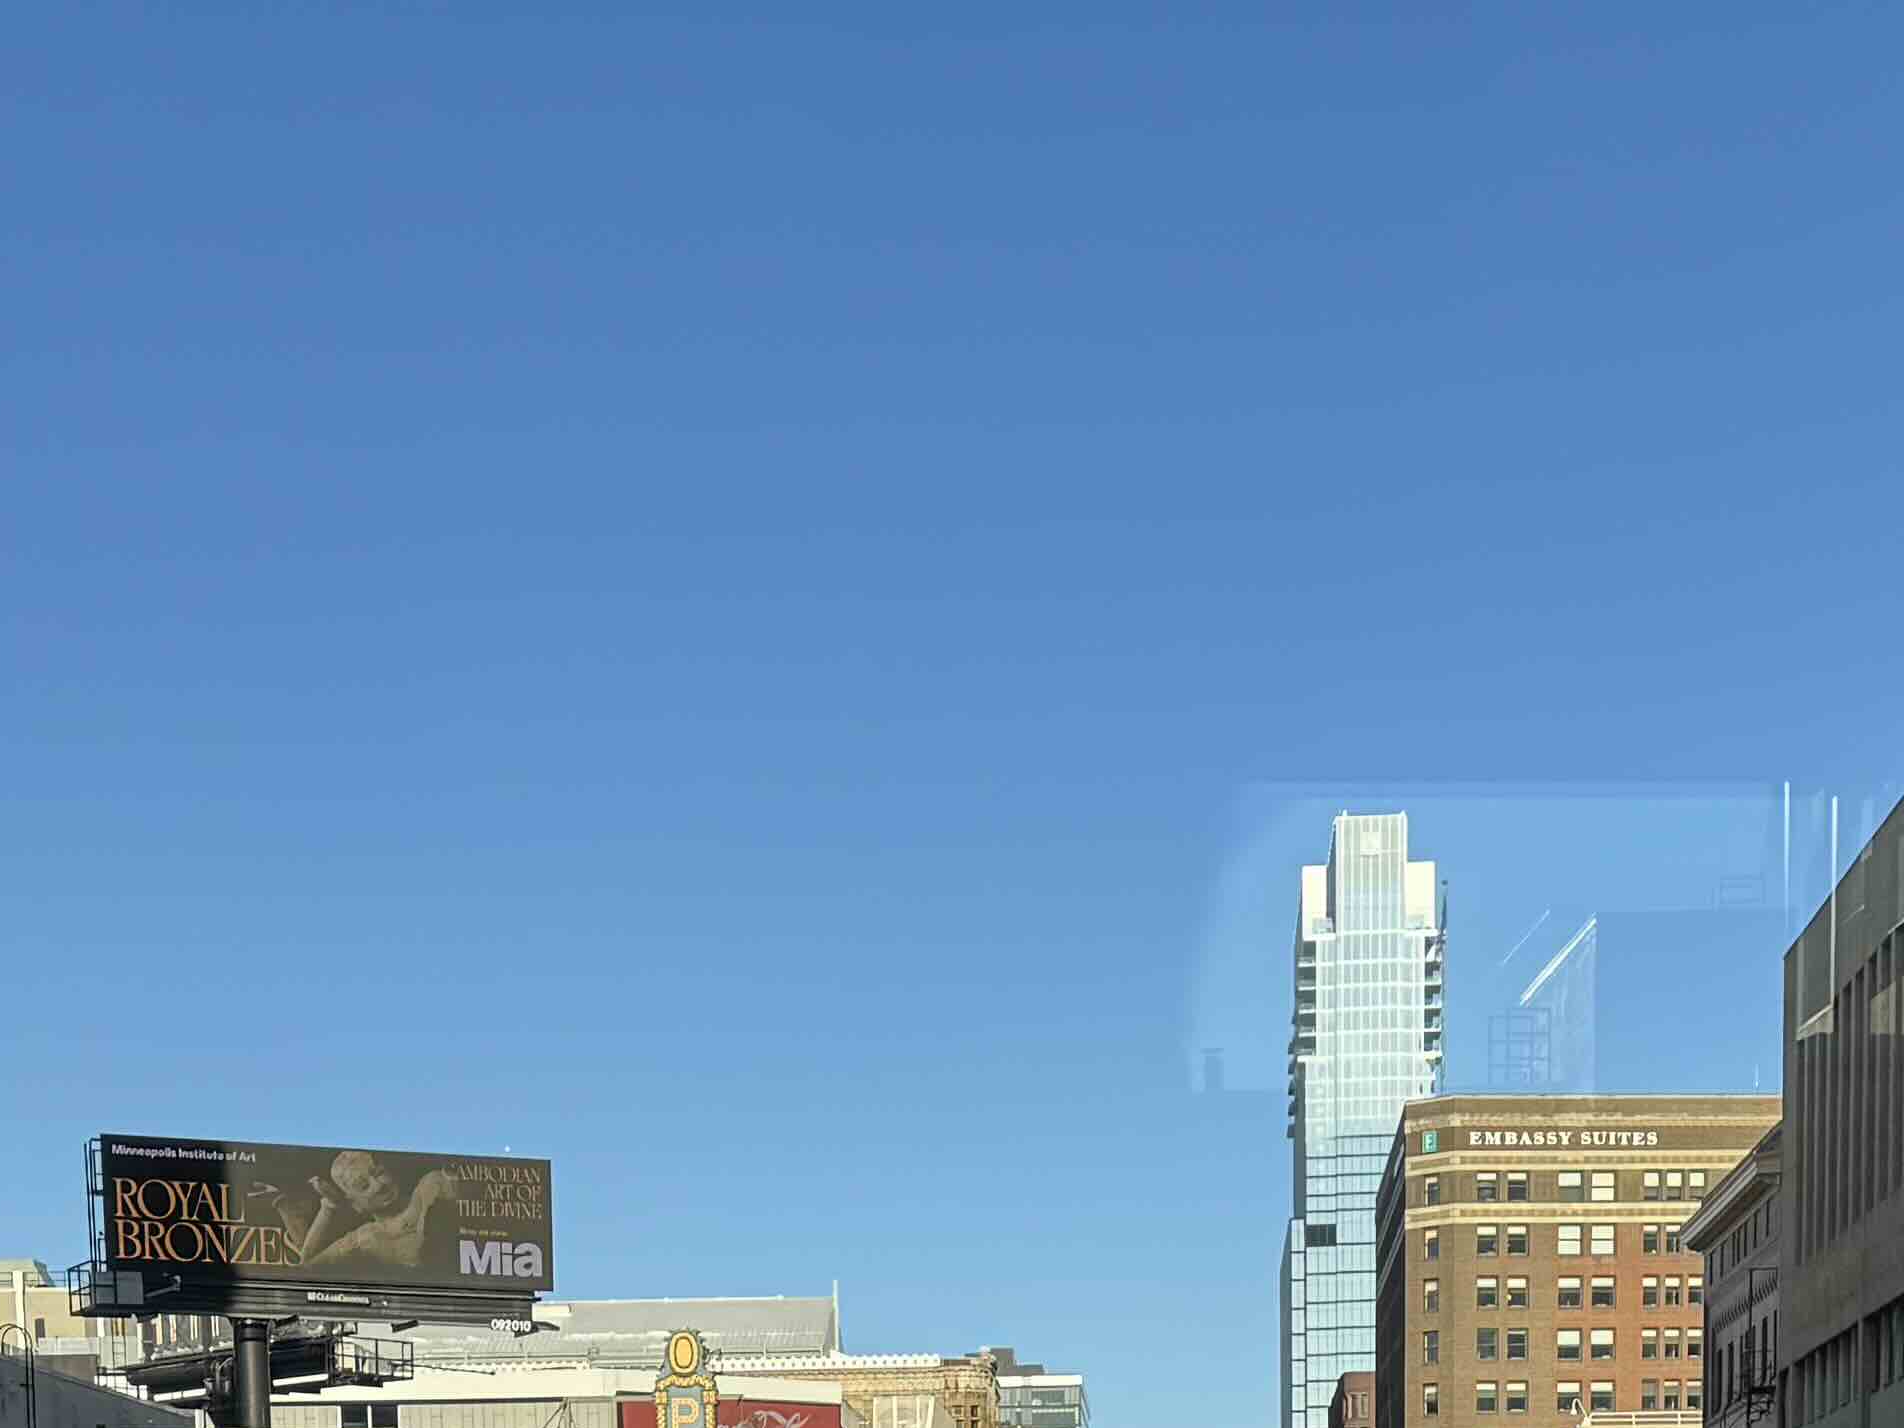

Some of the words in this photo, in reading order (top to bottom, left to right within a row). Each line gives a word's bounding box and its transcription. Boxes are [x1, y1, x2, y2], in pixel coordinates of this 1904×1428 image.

[1469, 1131, 1574, 1146] EMBASSY
[1580, 1131, 1658, 1146] SUITES
[111, 1144, 177, 1159] Minneapolis
[178, 1149, 224, 1161] Institute
[225, 1152, 237, 1162] of
[239, 1152, 256, 1163] Art
[112, 1177, 245, 1223] ROYAL
[484, 1183, 515, 1202] ART
[516, 1185, 541, 1203] OF
[457, 1200, 489, 1218] THE
[490, 1201, 542, 1220] DIVINE
[114, 1218, 305, 1267] BRONZES
[459, 1239, 544, 1278] Mia
[491, 1318, 532, 1332] 092010
